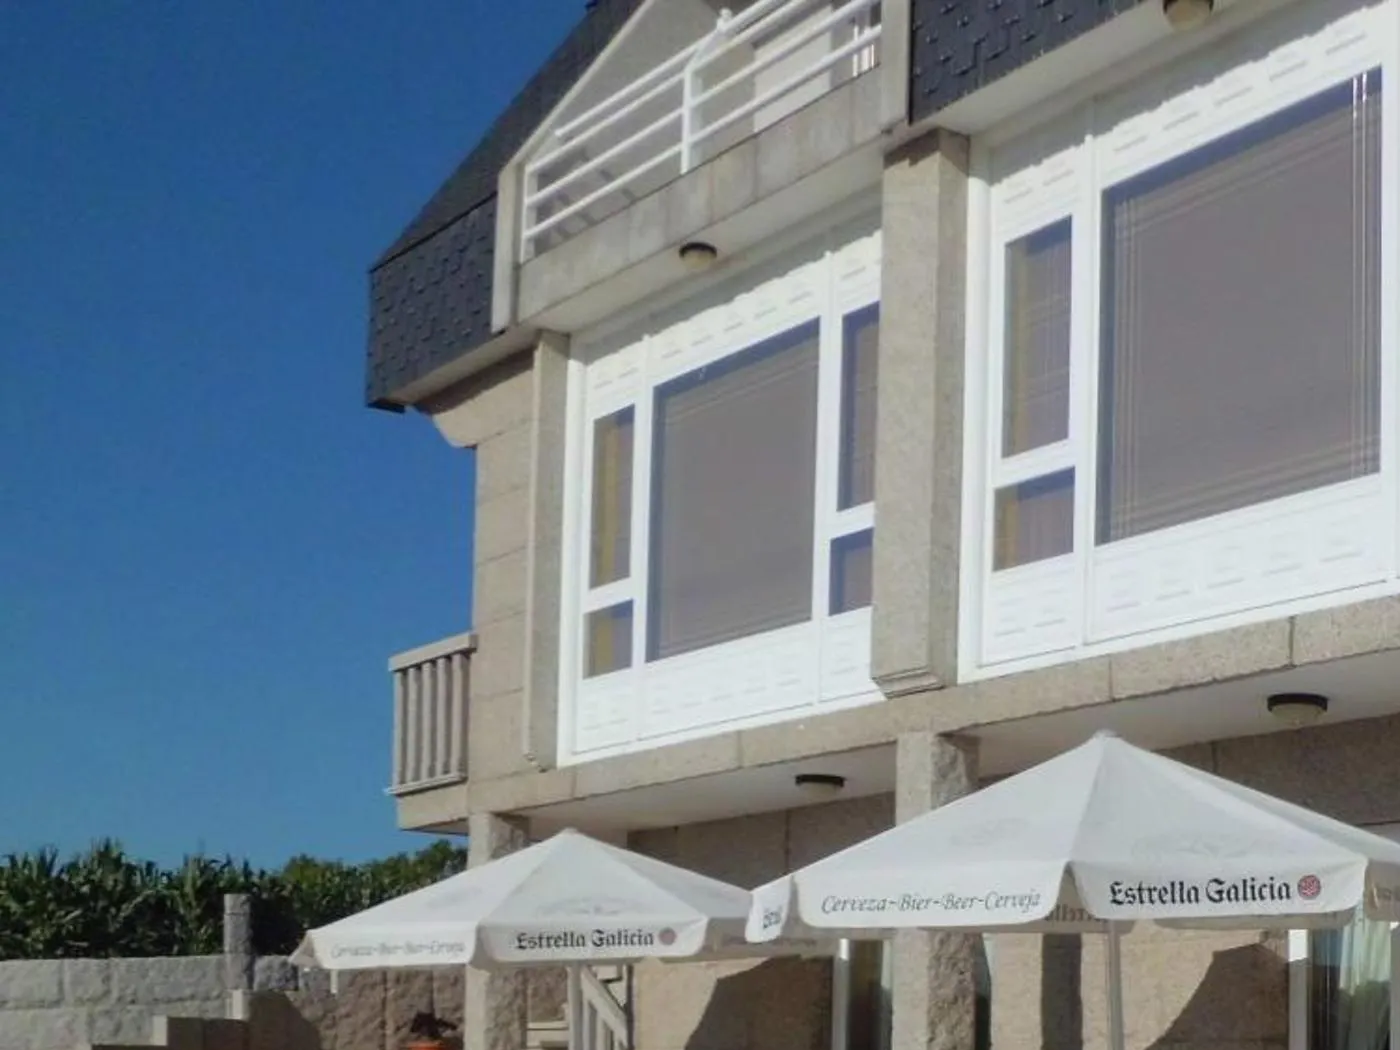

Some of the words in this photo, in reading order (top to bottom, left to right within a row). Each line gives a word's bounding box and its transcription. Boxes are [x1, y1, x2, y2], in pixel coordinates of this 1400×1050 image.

[1109, 878, 1200, 907] Estrella
[1205, 876, 1292, 904] Galicia
[516, 930, 586, 951] Estrella
[591, 928, 654, 947] Galicia
